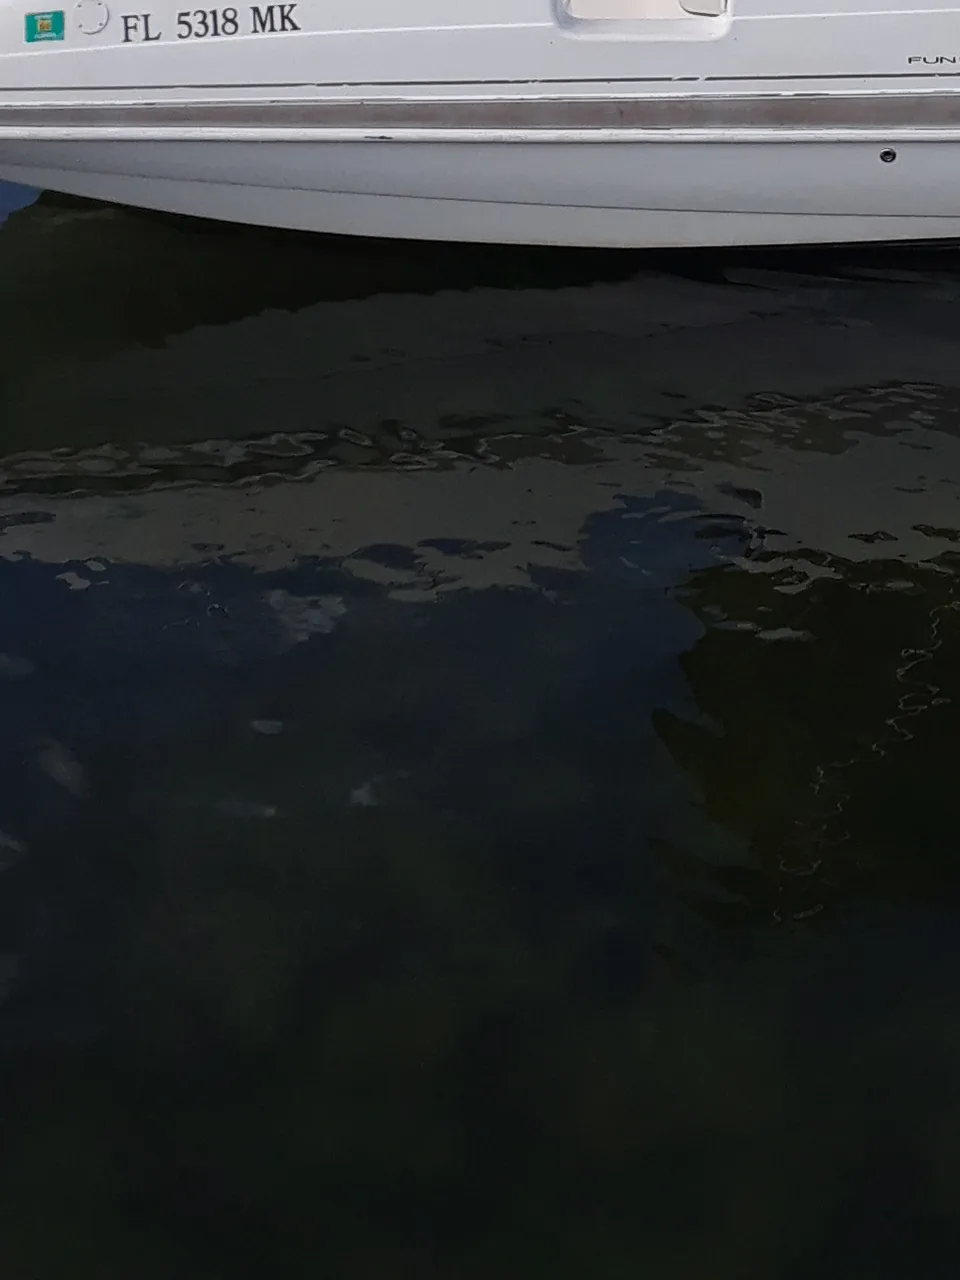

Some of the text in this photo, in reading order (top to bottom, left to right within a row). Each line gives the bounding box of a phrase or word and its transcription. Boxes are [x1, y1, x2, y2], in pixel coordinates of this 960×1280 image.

[121, 3, 302, 42] FL 5318 MK
[908, 56, 956, 64] FUN
